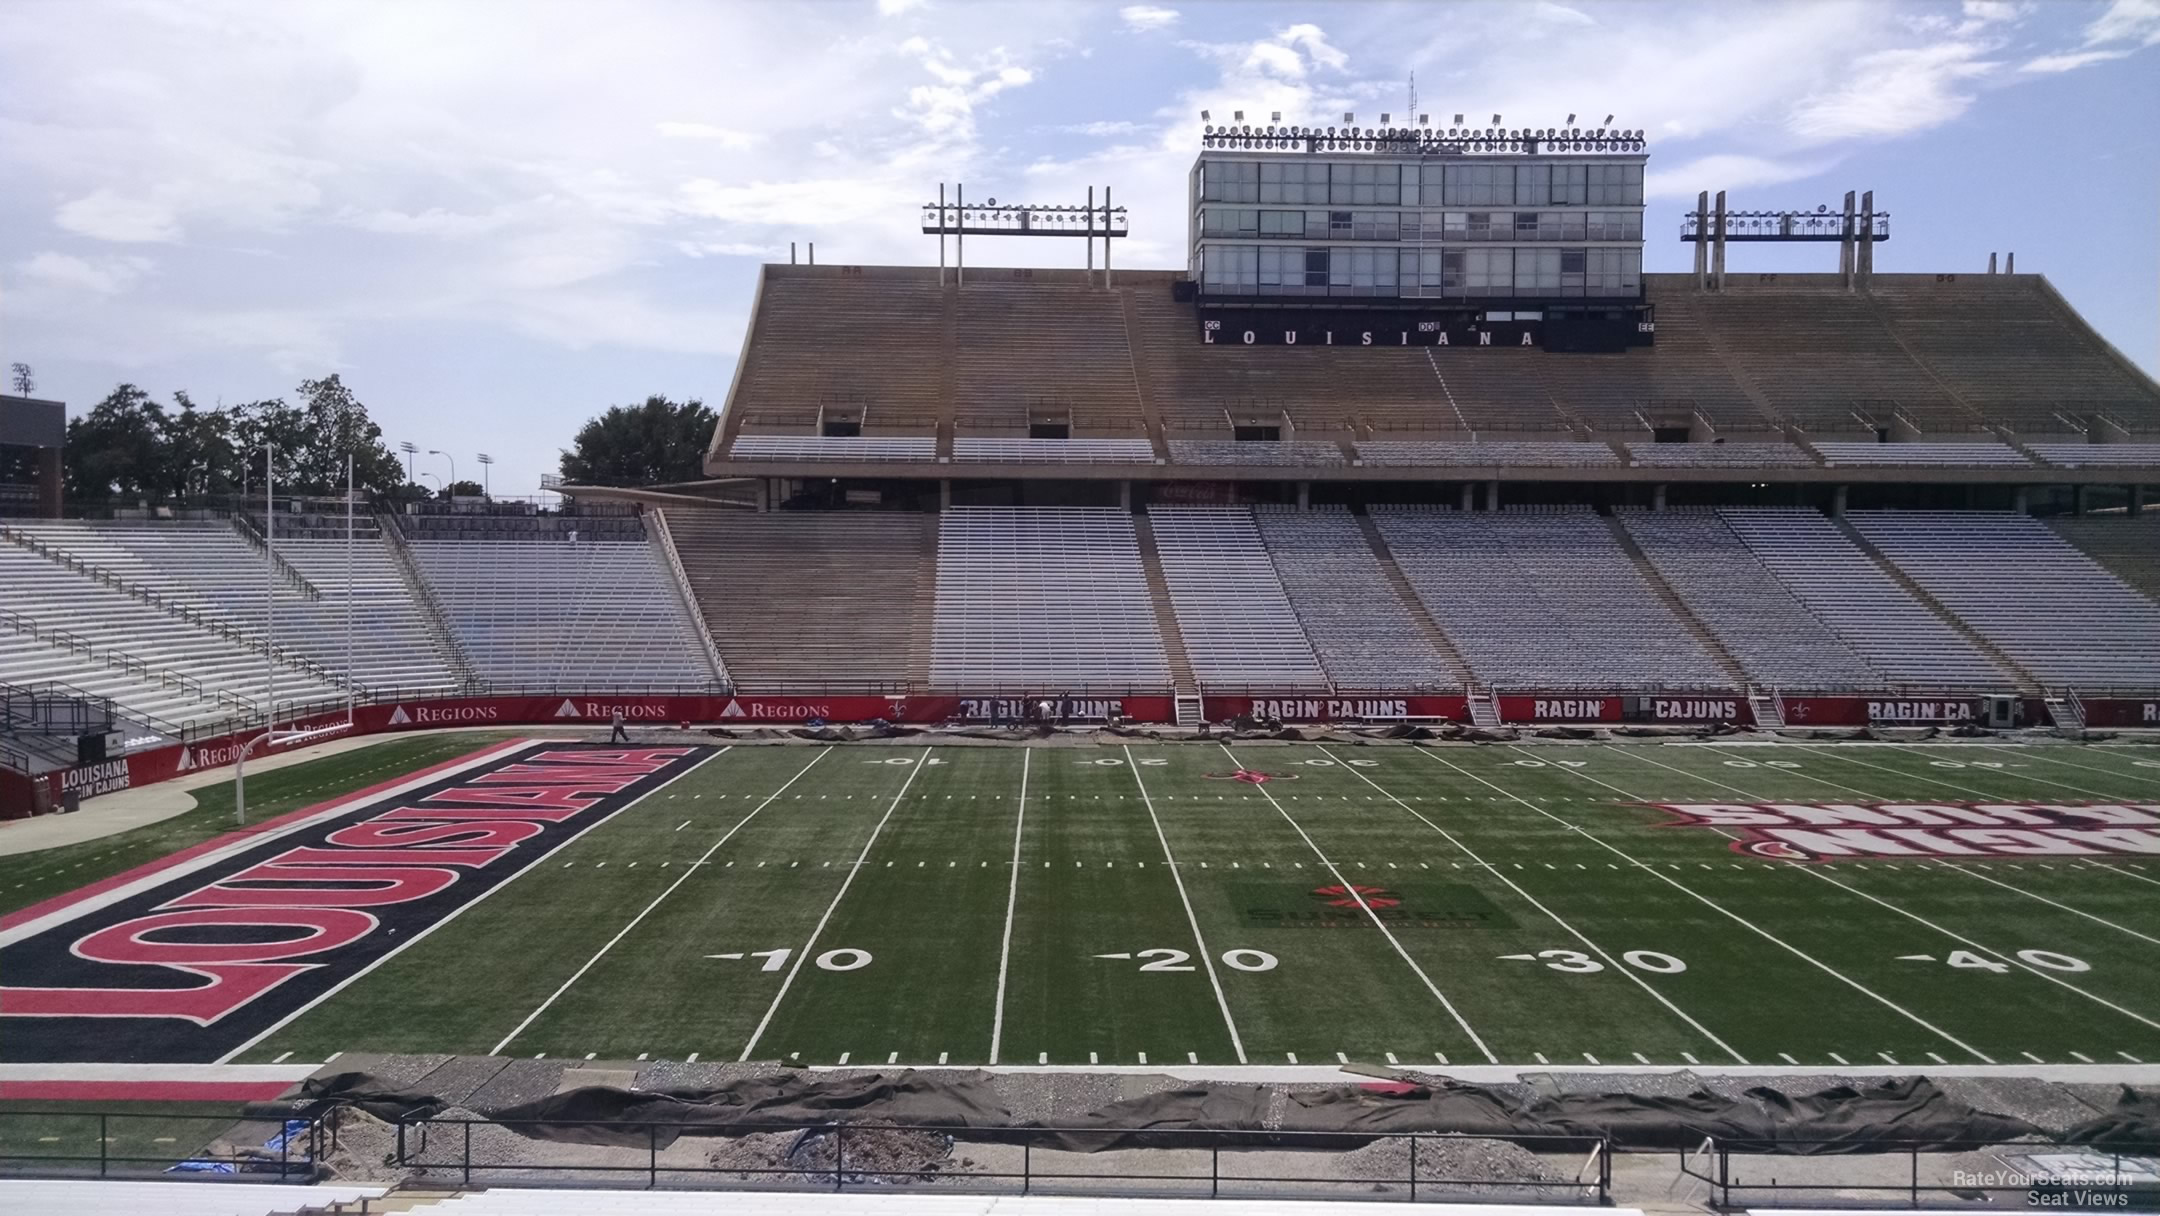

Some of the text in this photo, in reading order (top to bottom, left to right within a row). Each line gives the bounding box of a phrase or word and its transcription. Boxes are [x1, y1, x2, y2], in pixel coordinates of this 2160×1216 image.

[1205, 321, 1220, 330] CC
[1204, 331, 1533, 345] LOUISIANA
[416, 706, 498, 722] REGIONS
[585, 702, 666, 718] REGIONS
[751, 703, 830, 718] REGIONS
[1327, 700, 1408, 718] CAJUNS
[1655, 701, 1737, 718] CAJUNS
[61, 758, 129, 789] LOUISIANA
[96, 775, 130, 795] CAJUNS
[1660, 804, 2160, 826] AJUNS
